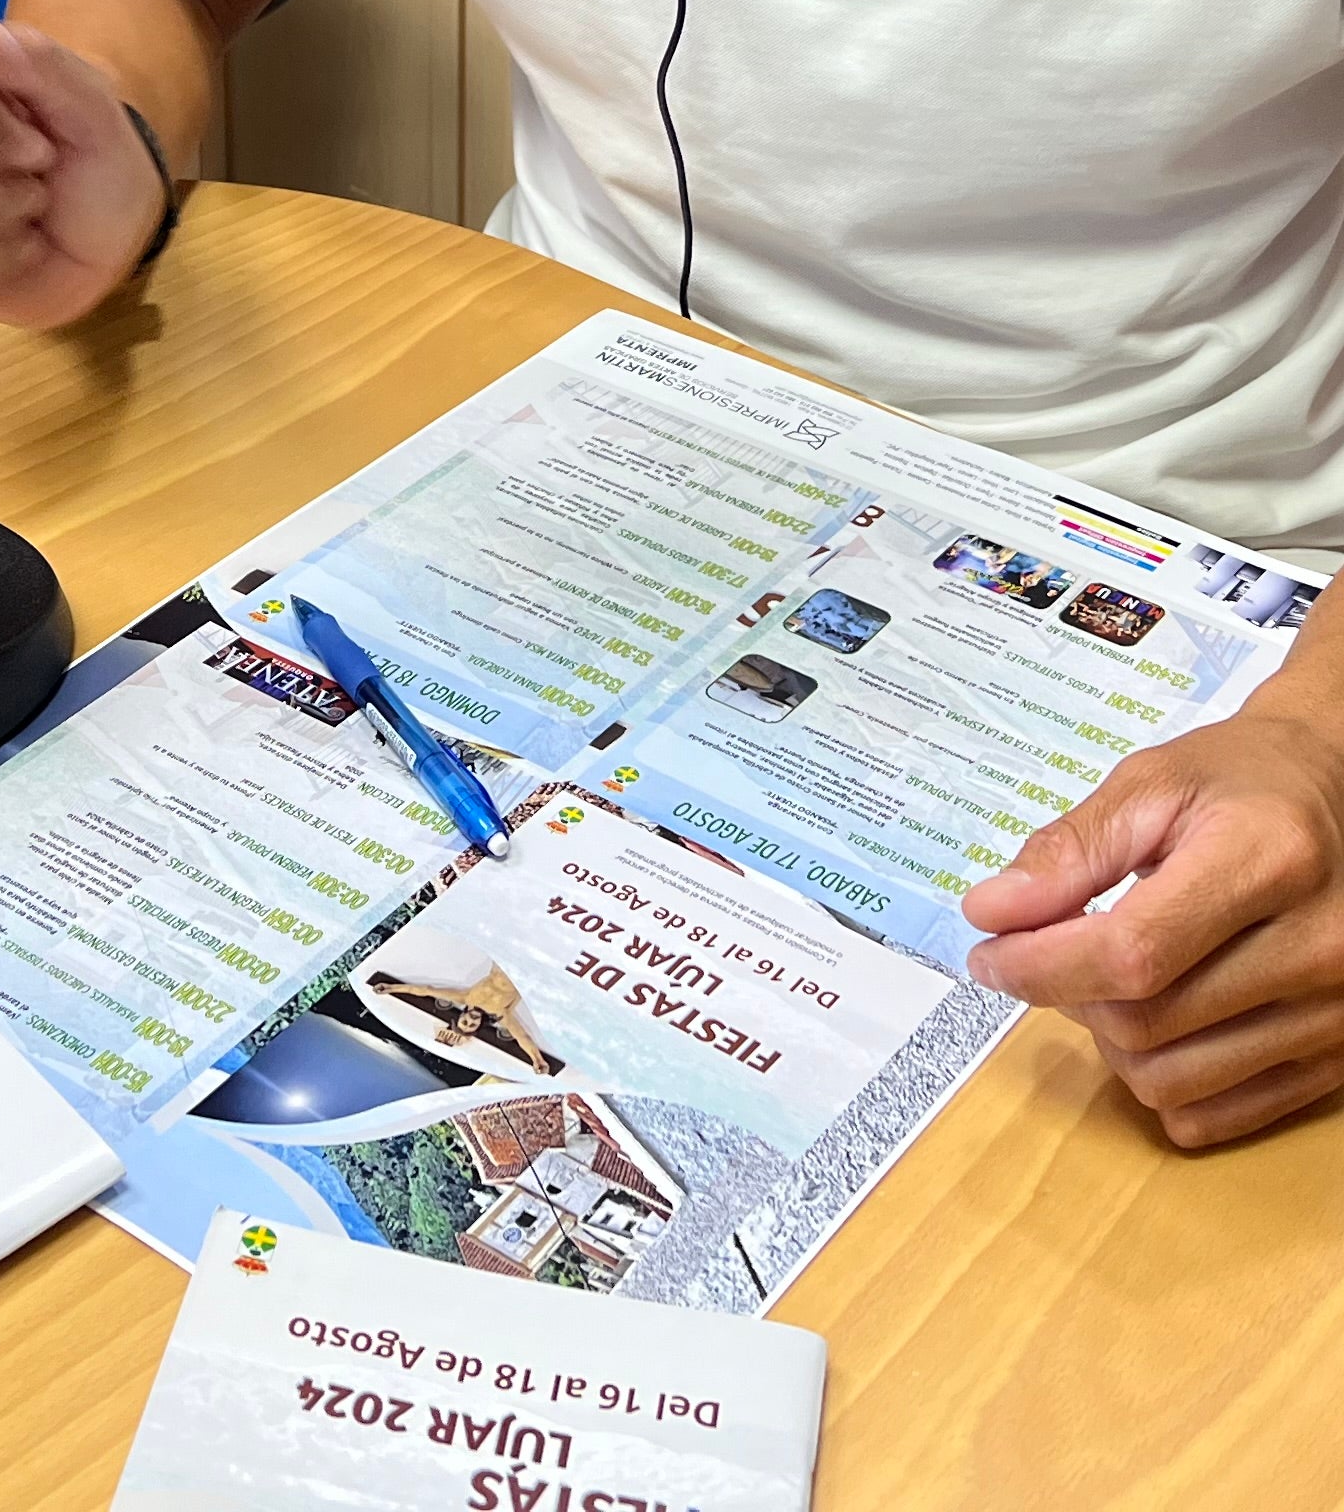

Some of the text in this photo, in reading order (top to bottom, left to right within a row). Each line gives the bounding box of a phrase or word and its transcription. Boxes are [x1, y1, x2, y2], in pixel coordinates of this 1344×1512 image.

[612, 335, 698, 371] IMPRENTA
[646, 361, 677, 375] ARTES
[675, 514, 693, 524] DE
[722, 495, 766, 515] VERBENA
[688, 519, 735, 541] CARRERA
[760, 508, 817, 536] 22:00H
[585, 593, 604, 604] DE
[598, 598, 640, 619] TORNEO
[1083, 582, 1166, 620] MANIGUA
[542, 650, 580, 669] SANTA
[1088, 642, 1136, 666] VERBENA
[215, 645, 342, 711] ATENEA
[391, 668, 421, 687] 18
[509, 673, 546, 693] DIANA
[568, 662, 630, 695] 13:00H
[1063, 676, 1106, 698] FUEGOS
[1132, 658, 1197, 691] 23:45H
[410, 676, 504, 725] DOMINGO,
[534, 684, 598, 718] 09:00H
[1101, 690, 1167, 725] 23:30H
[981, 725, 1000, 738] LA
[995, 732, 1015, 744] DE
[1072, 721, 1136, 755] 22:30H
[1011, 738, 1049, 759] FIESTA
[1043, 751, 1106, 784] 17:30H
[398, 800, 461, 837] 01:00H
[949, 795, 993, 819] PAELLA
[307, 816, 327, 829] DE
[320, 823, 358, 845] FIESTA
[922, 826, 963, 849] SANTA
[267, 851, 316, 880] VERBENA
[351, 836, 417, 876] 00:30H
[623, 846, 679, 877] programadas
[673, 803, 891, 912] SÁBADO, 17 DE AGOSTO
[898, 856, 937, 878] DIANA
[200, 876, 221, 889] LA
[213, 883, 234, 896] DE
[305, 870, 372, 911] 00:30H
[676, 873, 725, 900] actividades
[223, 890, 271, 919] PREGÓN
[615, 853, 838, 967] La Comisión de Fiestas se reserva el derecho a cancelar
[722, 896, 738, 906] las
[735, 902, 750, 912] de
[260, 907, 326, 948] 00:15H
[747, 908, 795, 935] cualquiera
[184, 925, 227, 952] FUEGOS
[547, 897, 723, 996] LÚJAR 2024
[563, 863, 840, 1009] Del 16 al 18 de Agosto
[792, 931, 836, 955] modificar
[36, 960, 50, 970] Y
[129, 960, 181, 992] MUESTRA
[213, 942, 283, 986] 00:00H
[43, 963, 93, 994] CABEZUDOS
[168, 980, 238, 1025] 22:00H
[565, 951, 782, 1073] FIESTAS DE
[129, 1014, 197, 1059] 19:00H
[289, 1318, 719, 1428] Del 16 al 18 de Agosto
[297, 1378, 572, 1473] LÚJAR 2024
